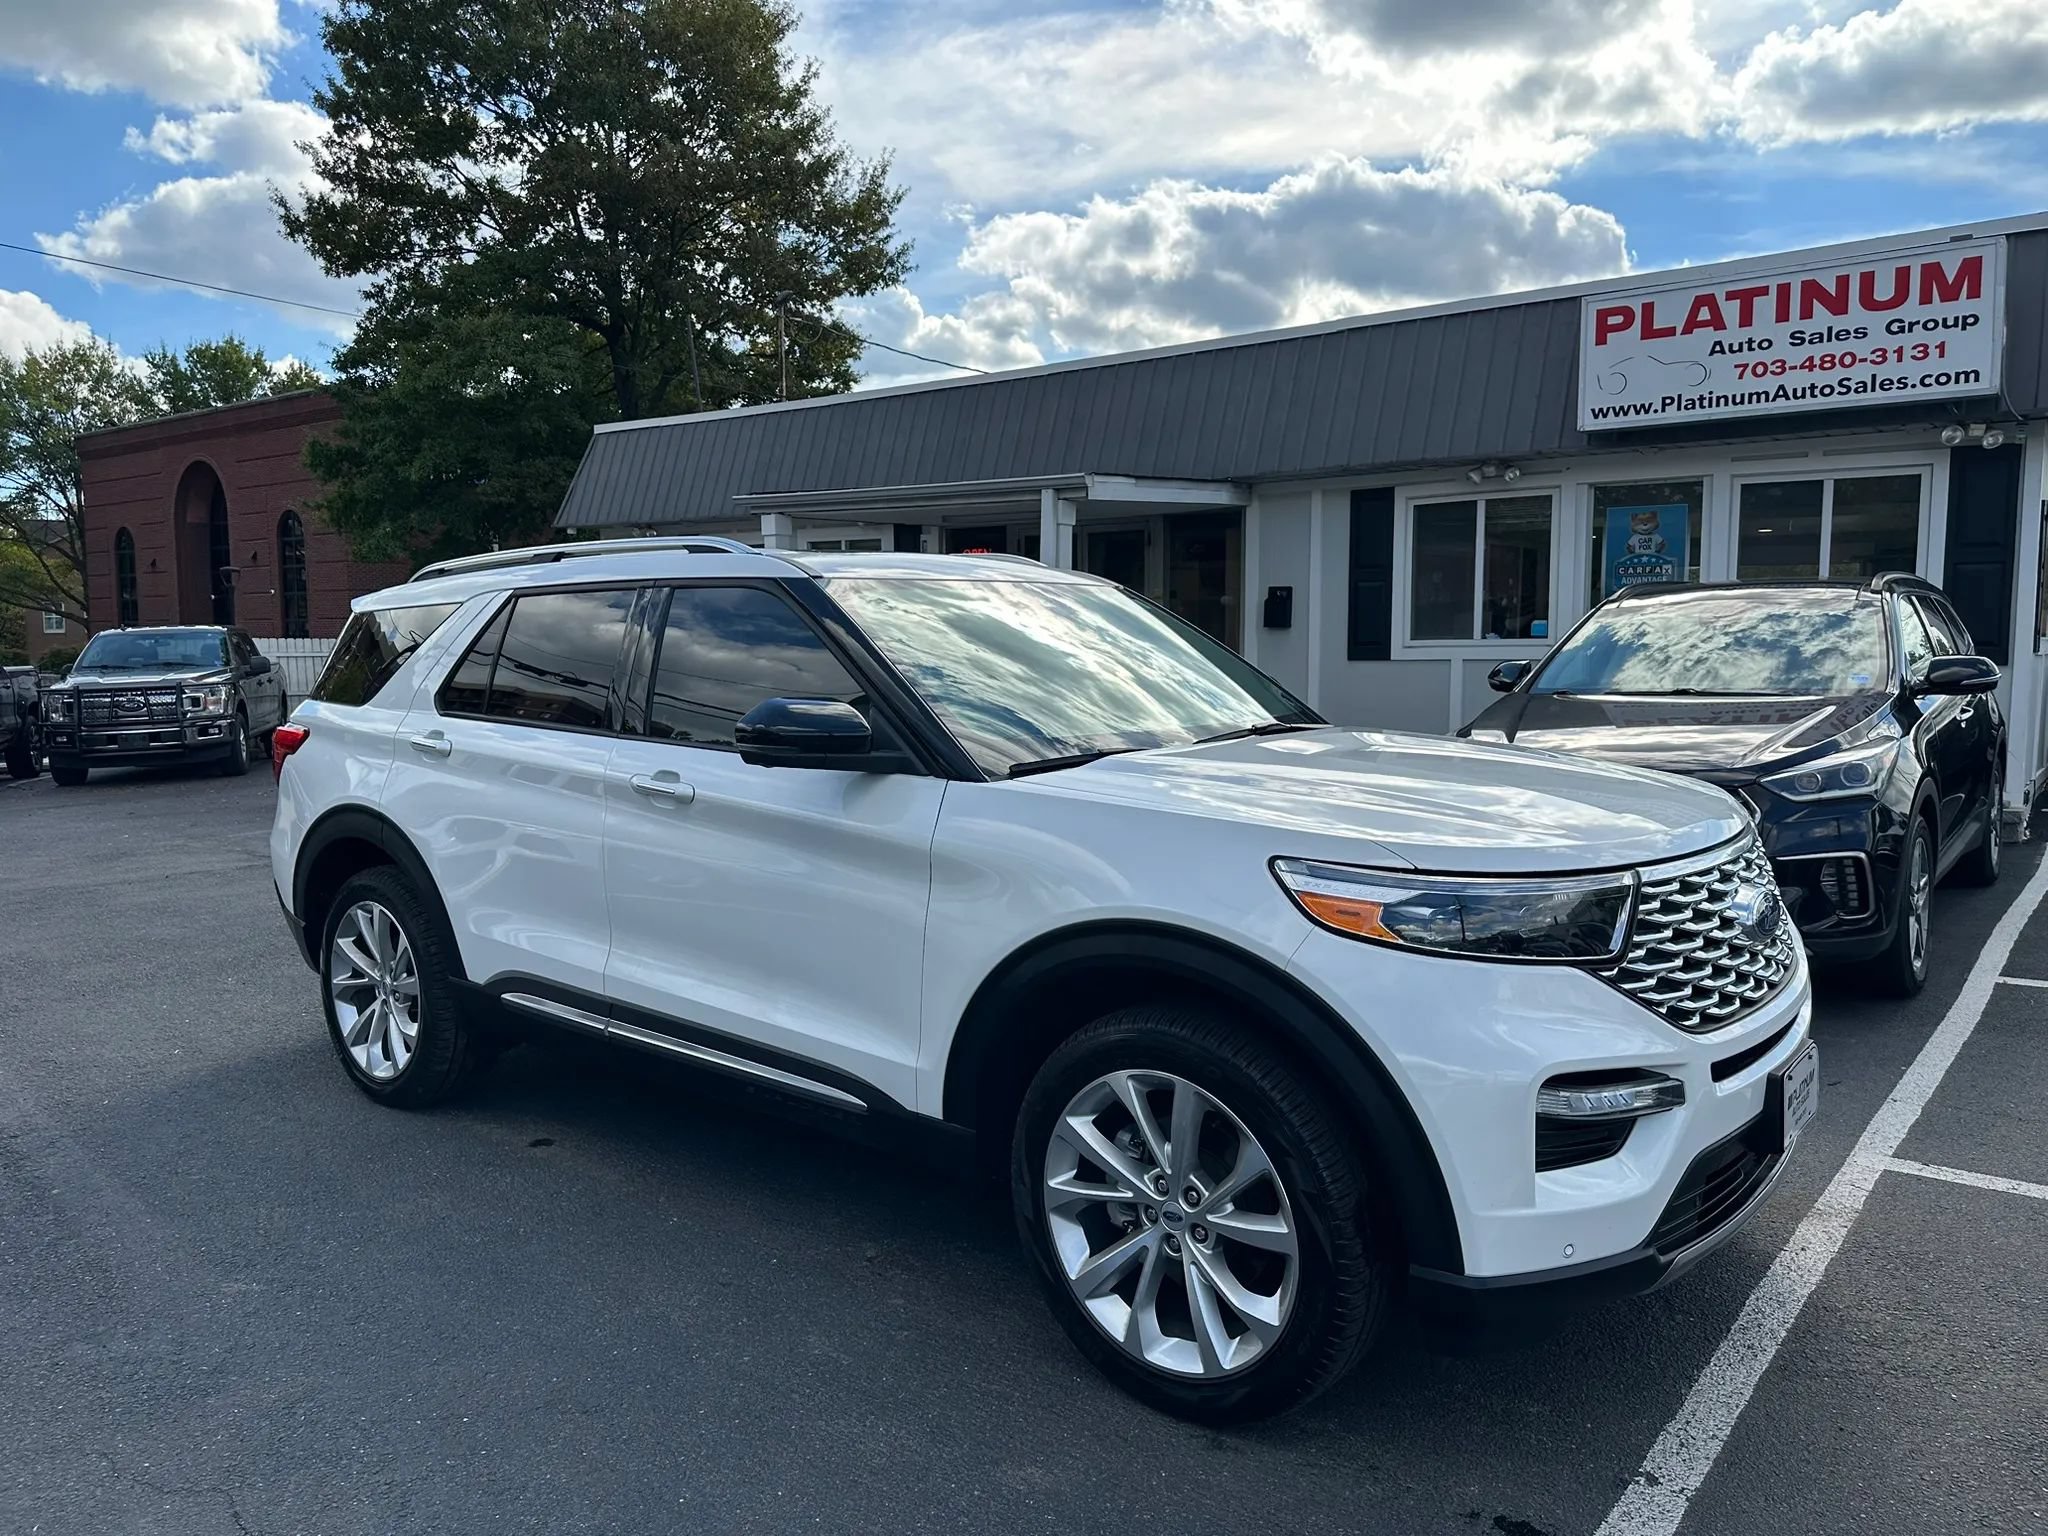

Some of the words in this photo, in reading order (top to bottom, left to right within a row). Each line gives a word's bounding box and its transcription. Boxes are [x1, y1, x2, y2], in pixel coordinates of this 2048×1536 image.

[1594, 257, 1983, 346] PLATINUM
[1708, 337, 1773, 356] Auto
[1788, 326, 1868, 347] Sales
[1885, 314, 1980, 336] Group
[1734, 341, 1947, 380] 703-480-3131
[1590, 368, 1980, 420] www.PlatinumAutoSales.com
[1618, 565, 1671, 575] CARFAX
[1620, 576, 1667, 584] ADVANTAGE
